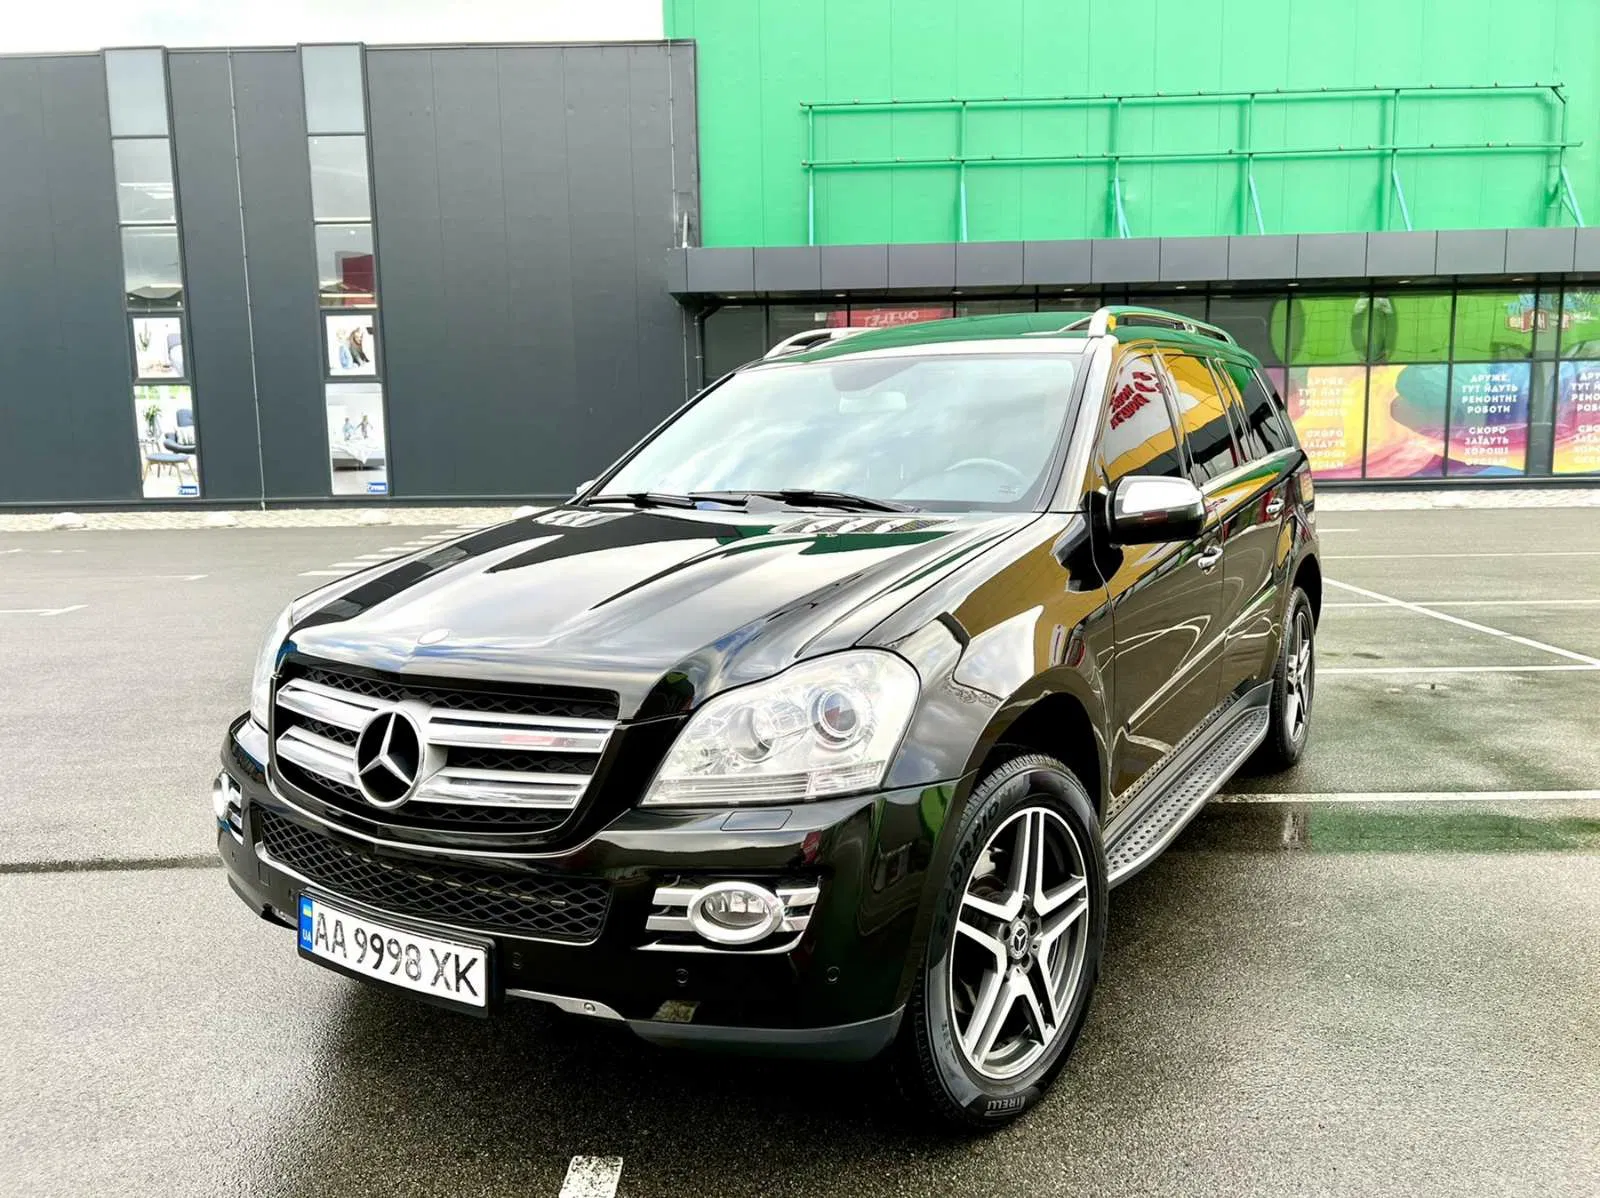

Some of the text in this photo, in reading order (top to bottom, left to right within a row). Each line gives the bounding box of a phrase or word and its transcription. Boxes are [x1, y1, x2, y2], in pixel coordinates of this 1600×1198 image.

[1462, 382, 1518, 393] ТУТ ЙДУТЬ
[1571, 382, 1591, 391] ТУТ
[1462, 394, 1517, 403] РЕМОНТНІ
[1467, 405, 1510, 414] РОБОТИ
[1576, 403, 1600, 412] РОБ
[1469, 426, 1506, 434] СКОРО
[1464, 435, 1509, 445] ЗАЇДУТЬ
[1464, 447, 1508, 455] ХОРОШІ
[302, 928, 312, 943] UA
[315, 912, 479, 997] AA 9998 XK
[984, 1096, 1025, 1116] PIRELLI
